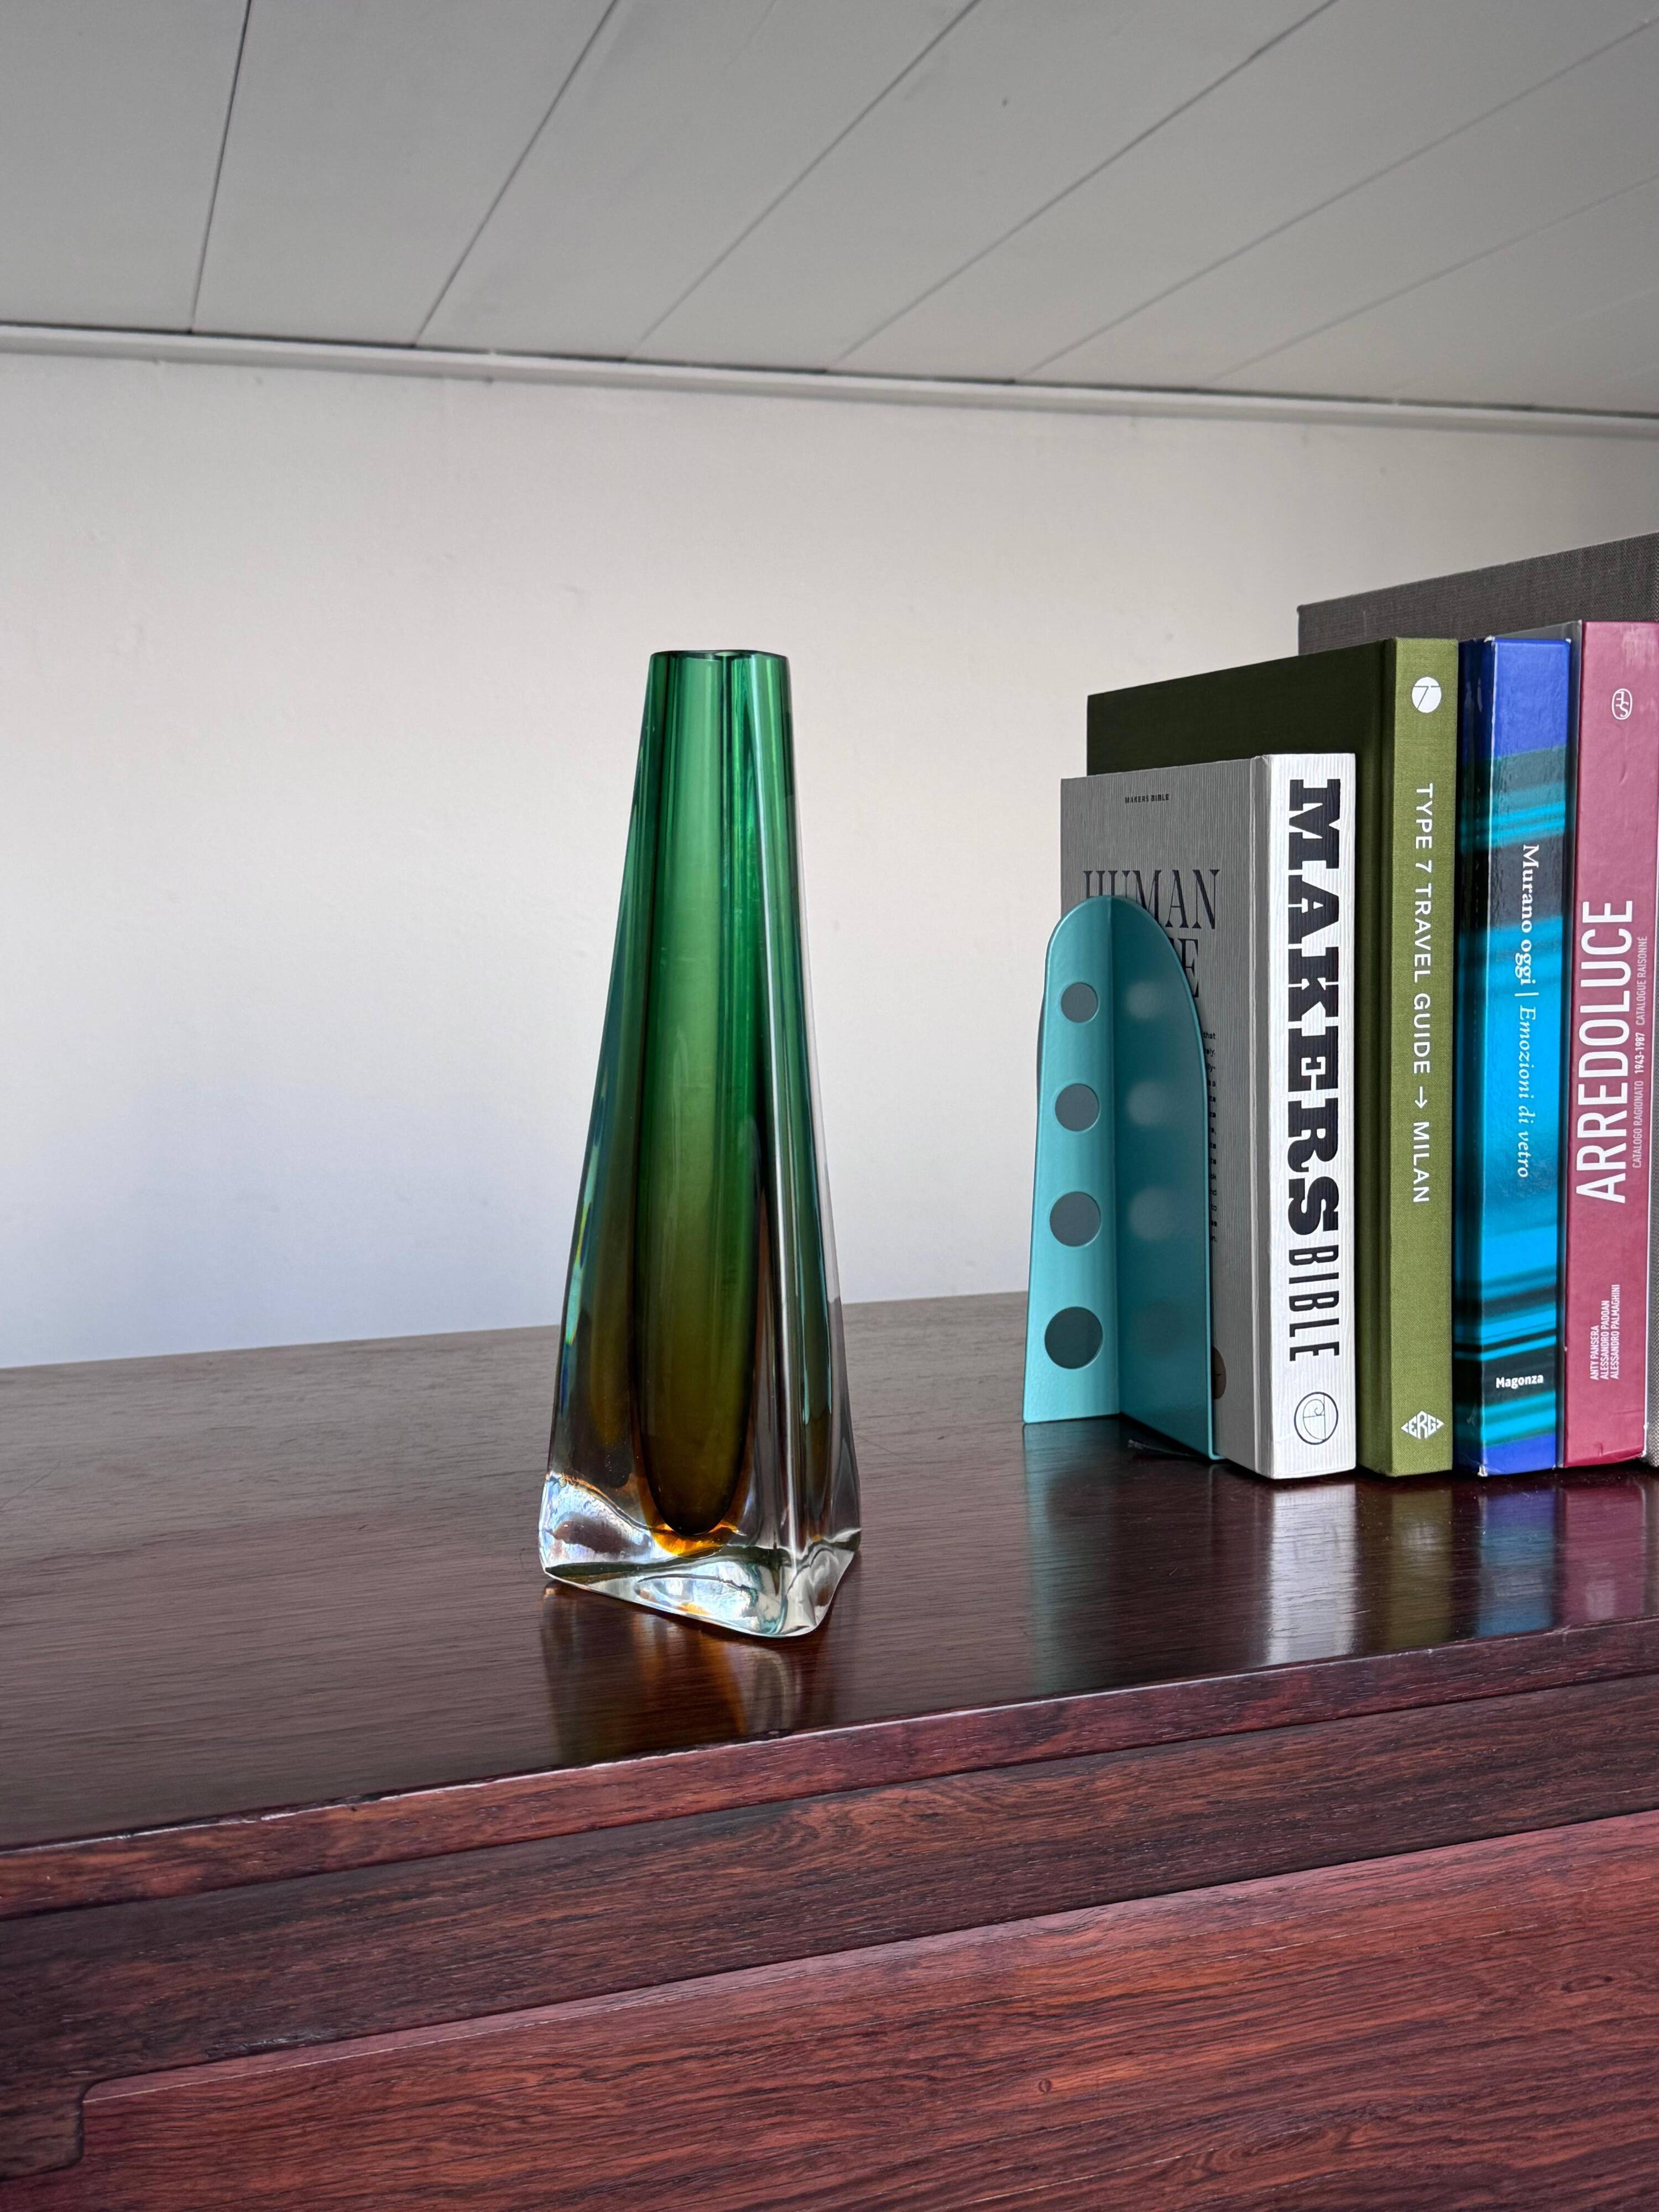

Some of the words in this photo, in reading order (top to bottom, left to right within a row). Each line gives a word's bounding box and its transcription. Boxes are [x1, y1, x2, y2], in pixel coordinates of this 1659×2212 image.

[1125, 795, 1149, 804] MAKERS
[1151, 794, 1170, 802] BIBLE
[1415, 782, 1433, 850] TYPE
[1415, 859, 1432, 873] 7
[1521, 844, 1540, 933] Murano
[1413, 883, 1432, 983] TRAVEL
[1515, 939, 1536, 985] oggi
[1636, 936, 1648, 978] RAISONNÉ
[1288, 778, 1341, 1236] MAKERS
[1635, 979, 1646, 1026] CATALOGUE
[1413, 993, 1431, 1074] GUIDE
[1518, 1005, 1536, 1099] Emozioni
[1576, 900, 1633, 1203] ARREDOLUCE
[1634, 1032, 1645, 1074] 1943-1987
[1518, 1105, 1536, 1124] di
[1633, 1080, 1644, 1126] RAGIONATO
[1413, 1121, 1430, 1202] MILAN
[1517, 1130, 1532, 1178] vetro
[1632, 1128, 1643, 1169] CATALOGO
[1288, 1244, 1340, 1362] BIBLE
[1600, 1300, 1610, 1330] PADOAN
[1610, 1284, 1620, 1329] PALMAGHINI
[1590, 1325, 1600, 1359] PANSERA
[1600, 1331, 1610, 1380] ALESSANDRO
[1610, 1331, 1620, 1380] ALESSANDRO
[1496, 1374, 1544, 1390] Magonza
[1590, 1360, 1599, 1381] ANTY
